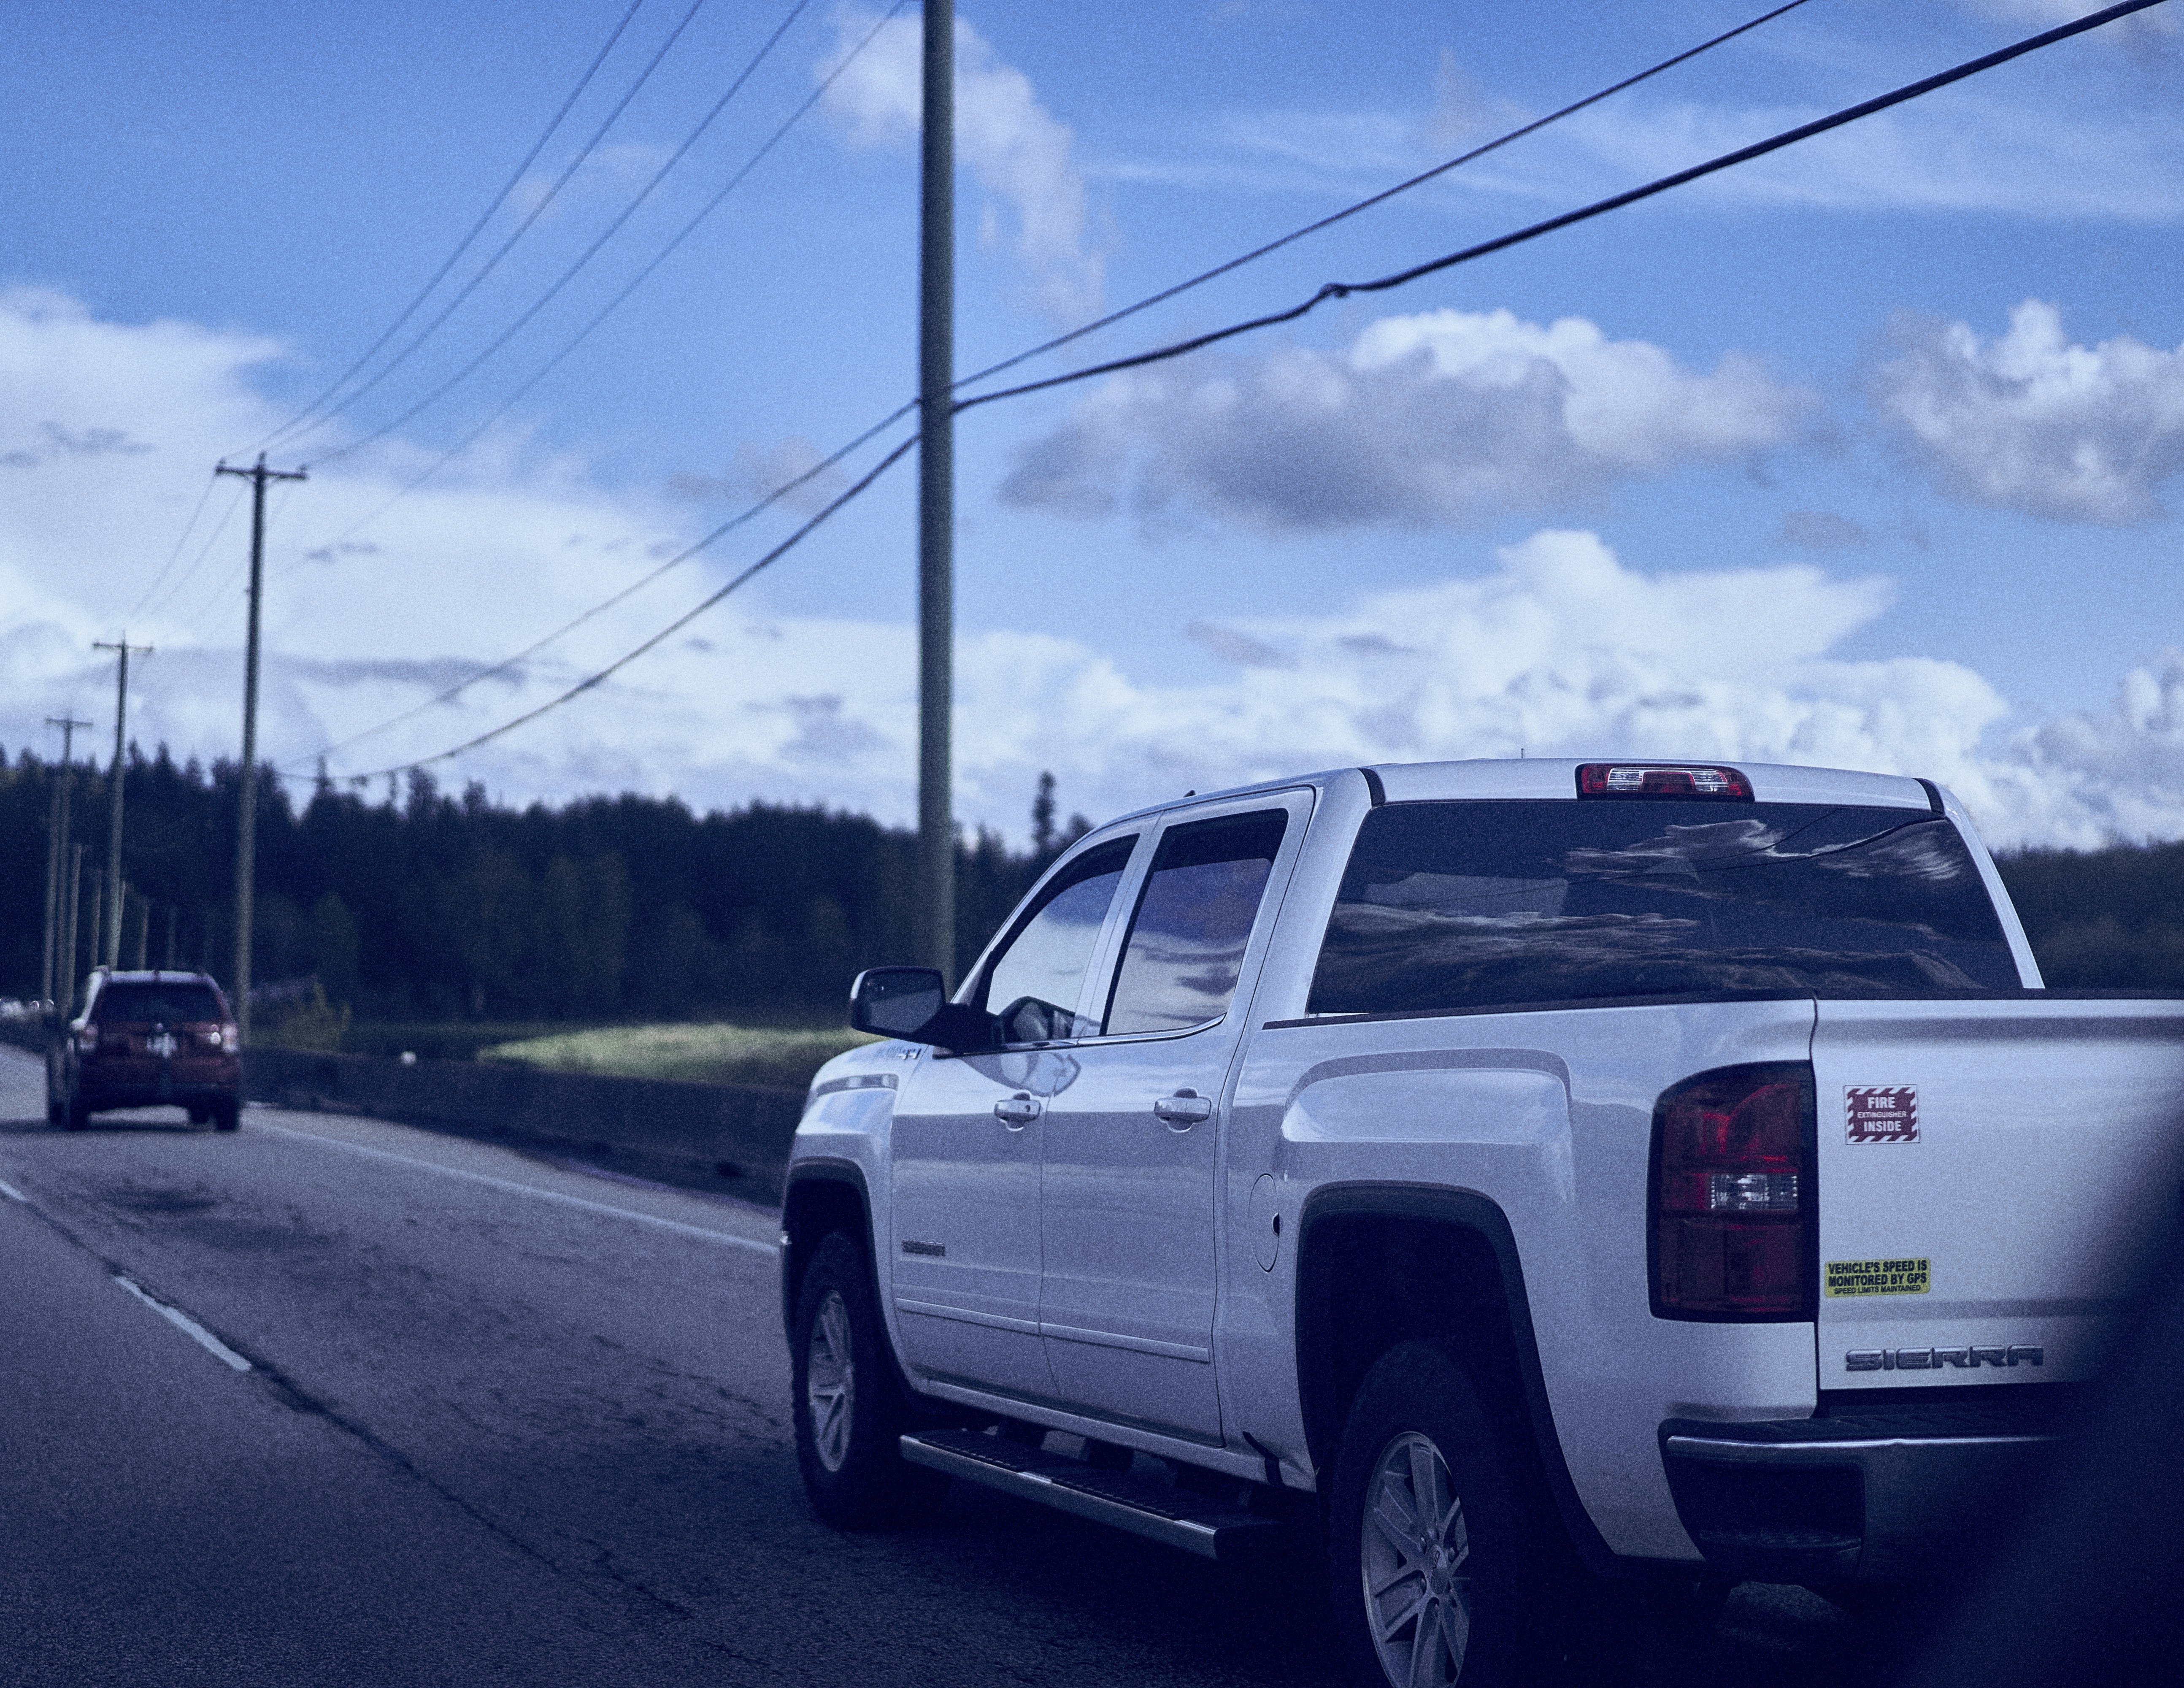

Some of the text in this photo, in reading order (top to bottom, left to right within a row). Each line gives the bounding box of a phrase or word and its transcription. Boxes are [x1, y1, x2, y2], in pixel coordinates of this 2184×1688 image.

[1868, 1097, 1895, 1108] FIRE
[1864, 1120, 1901, 1132] INSIDE
[1828, 1259, 1927, 1274] VEHICLE'S SPEED IS
[1828, 1272, 1927, 1287] MONITORED BY GPS
[1845, 1344, 2044, 1372] SIERRA
